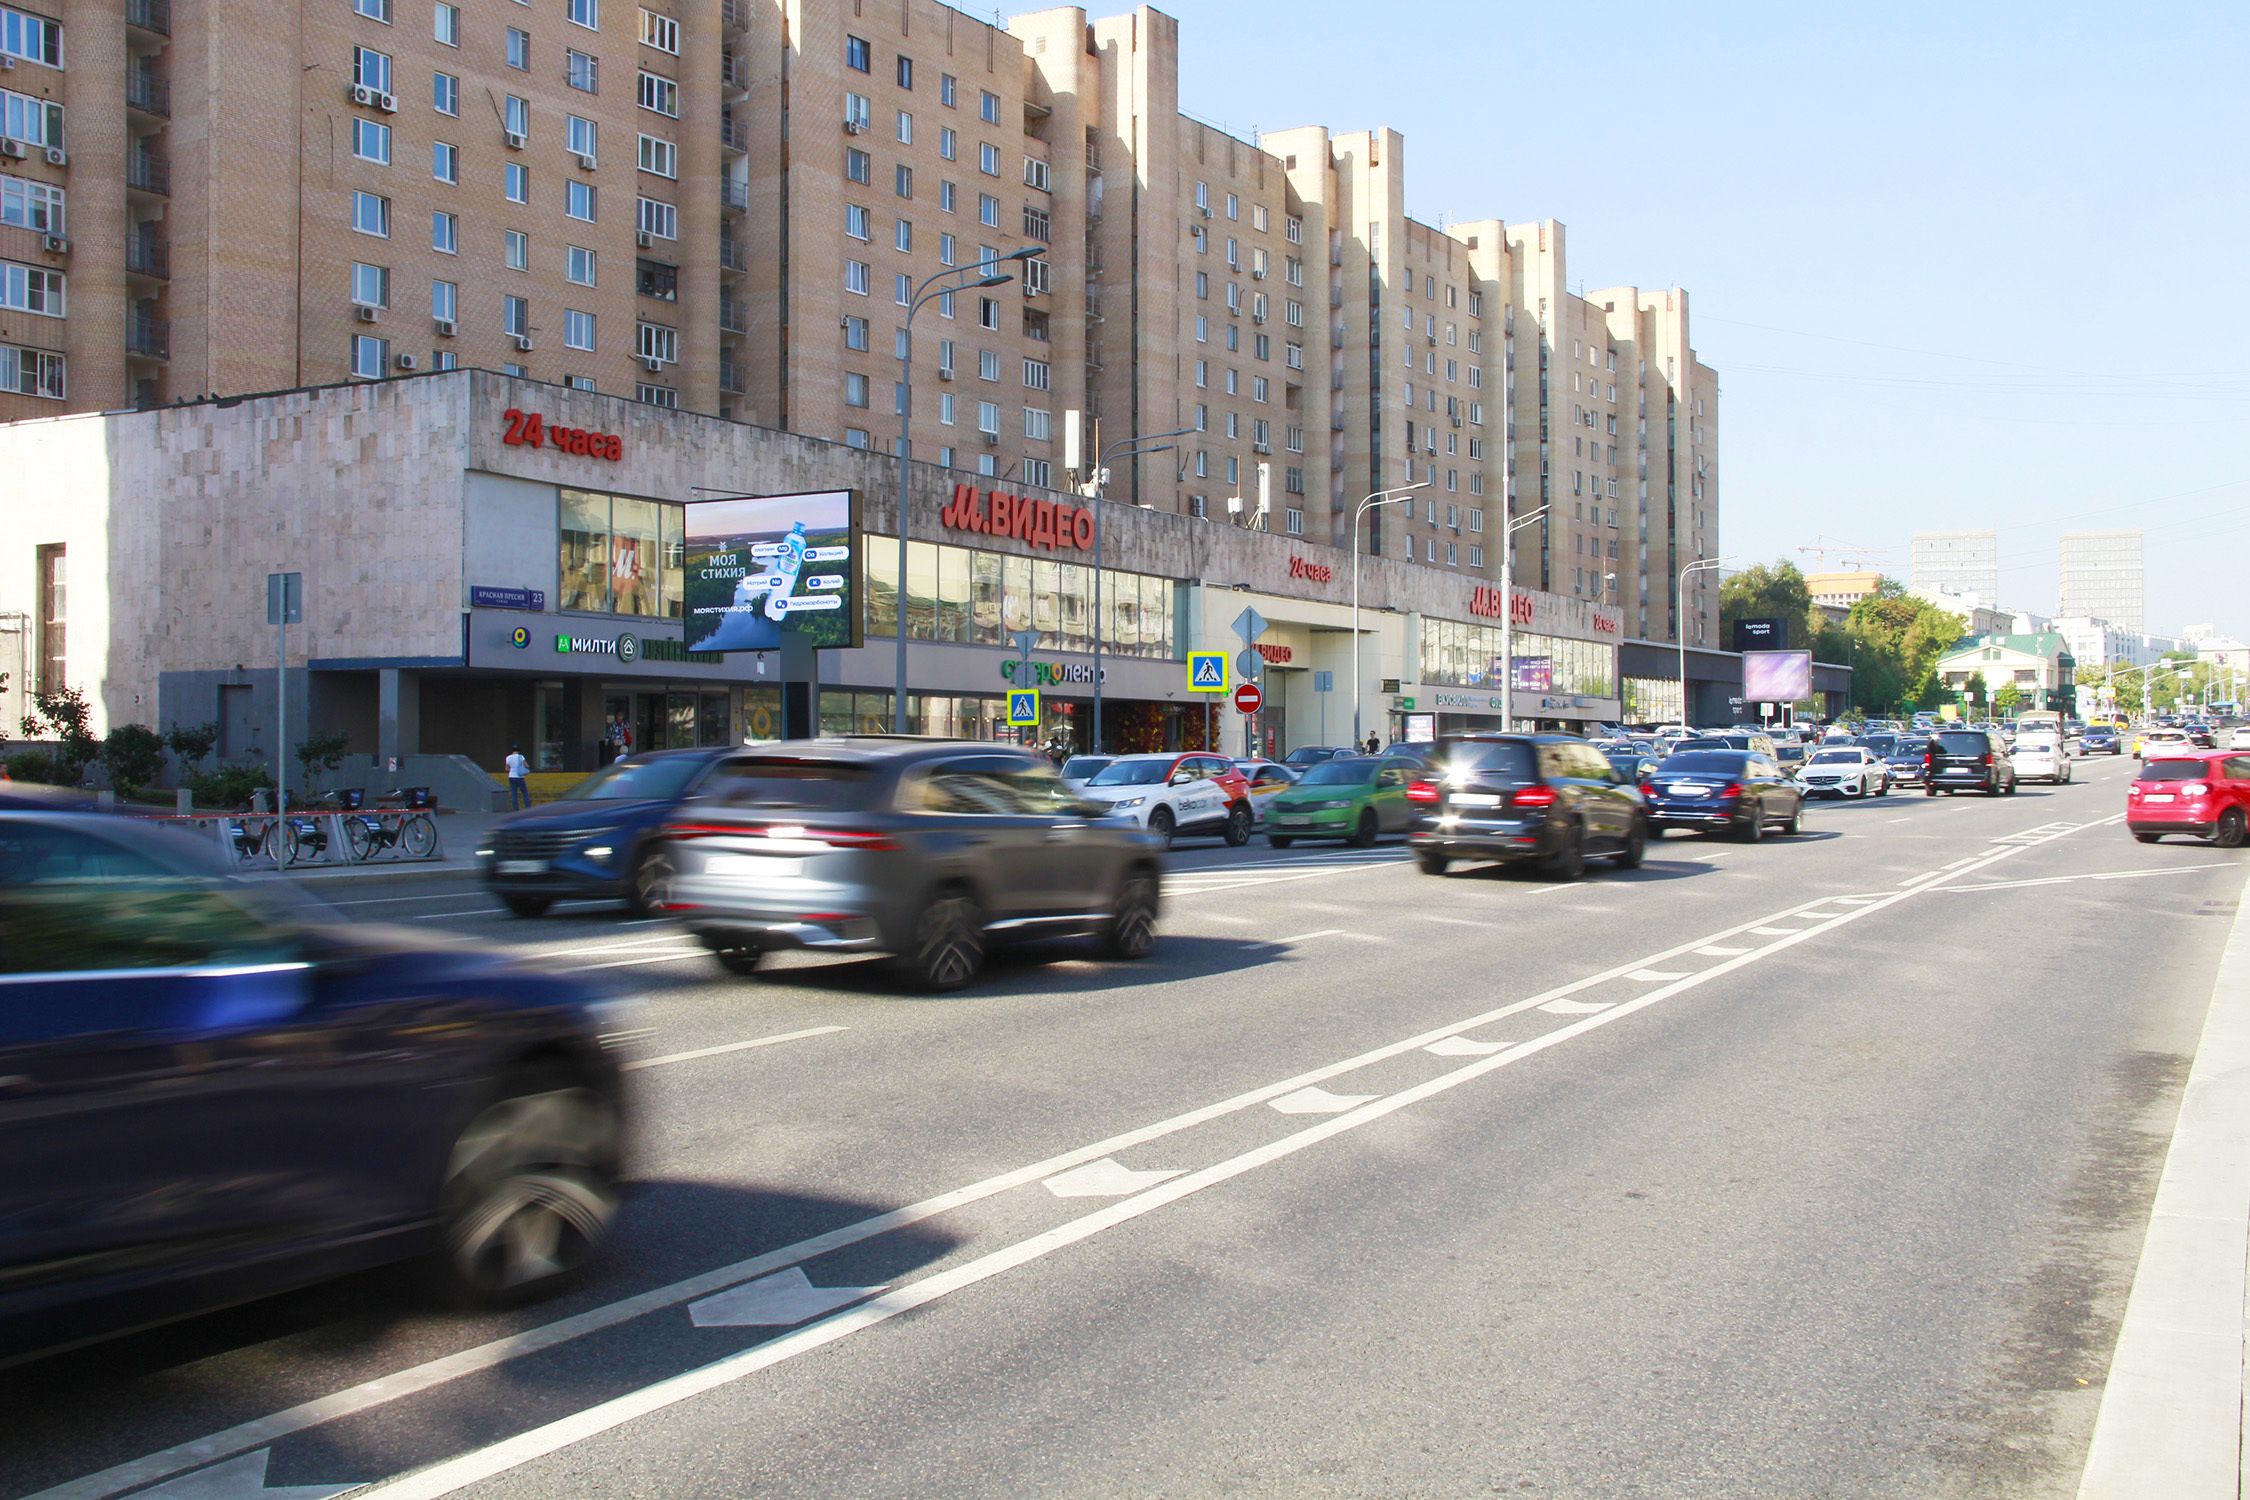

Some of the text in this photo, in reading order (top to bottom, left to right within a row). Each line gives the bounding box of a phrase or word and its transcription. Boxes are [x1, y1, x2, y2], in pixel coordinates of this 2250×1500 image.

[503, 408, 622, 461] 24 часа
[942, 484, 1095, 550] М.ВИДЕО
[709, 554, 737, 566] МОЯ
[701, 567, 746, 580] СТИХИЯ
[1290, 556, 1332, 583] 24 часа
[479, 591, 525, 601] КРАСНАЯ ПРЕСНЯ
[533, 593, 543, 603] 23
[693, 604, 753, 614] моястихия.рф
[790, 599, 838, 607] Гидрокарбонаты
[1470, 586, 1535, 625] М.ВДЕО
[571, 638, 616, 654] МИЛТИ
